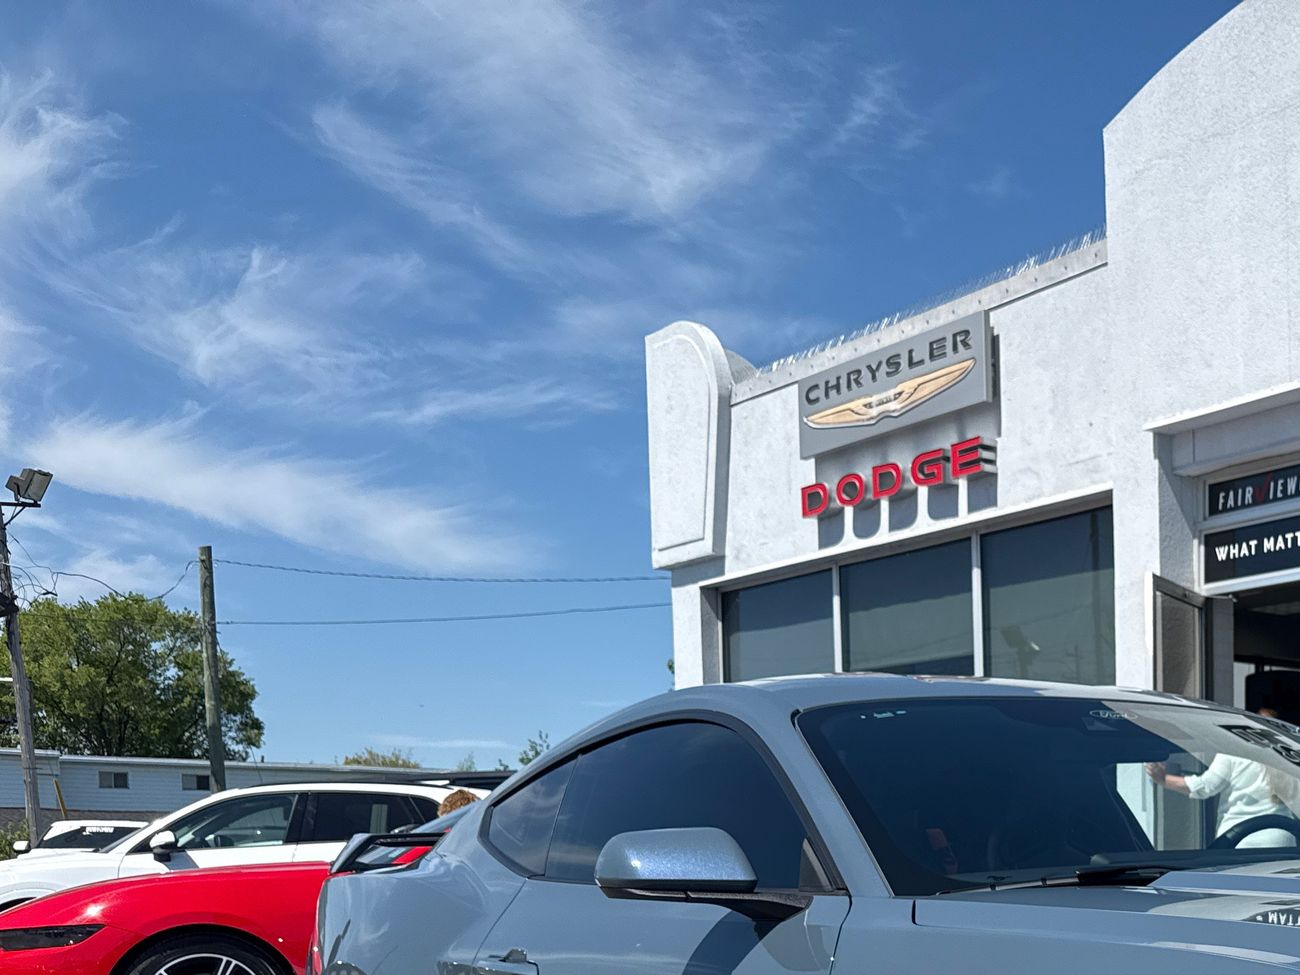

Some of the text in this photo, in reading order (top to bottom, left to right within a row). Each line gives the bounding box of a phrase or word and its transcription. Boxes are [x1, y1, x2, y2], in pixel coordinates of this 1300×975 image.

[806, 329, 972, 405] CHRYSLER
[801, 436, 983, 518] DODGE
[1215, 540, 1257, 561] WHAT
